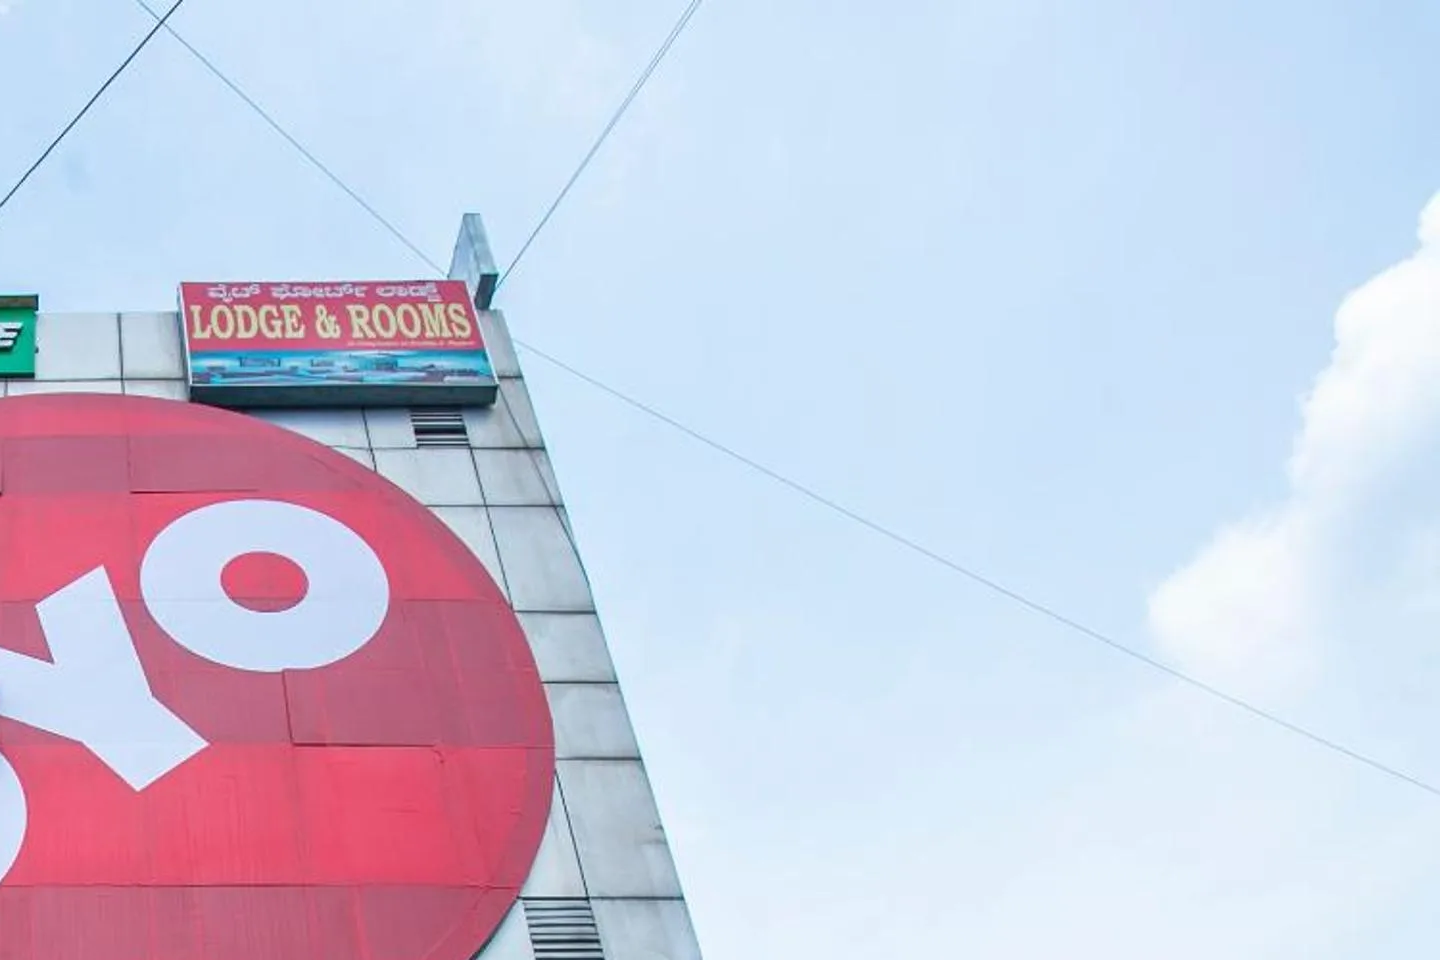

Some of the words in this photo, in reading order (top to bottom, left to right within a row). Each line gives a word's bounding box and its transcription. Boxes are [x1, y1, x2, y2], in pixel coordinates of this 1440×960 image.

[191, 304, 306, 339] LODGE
[315, 305, 340, 339] &
[347, 303, 473, 338] ROOMS
